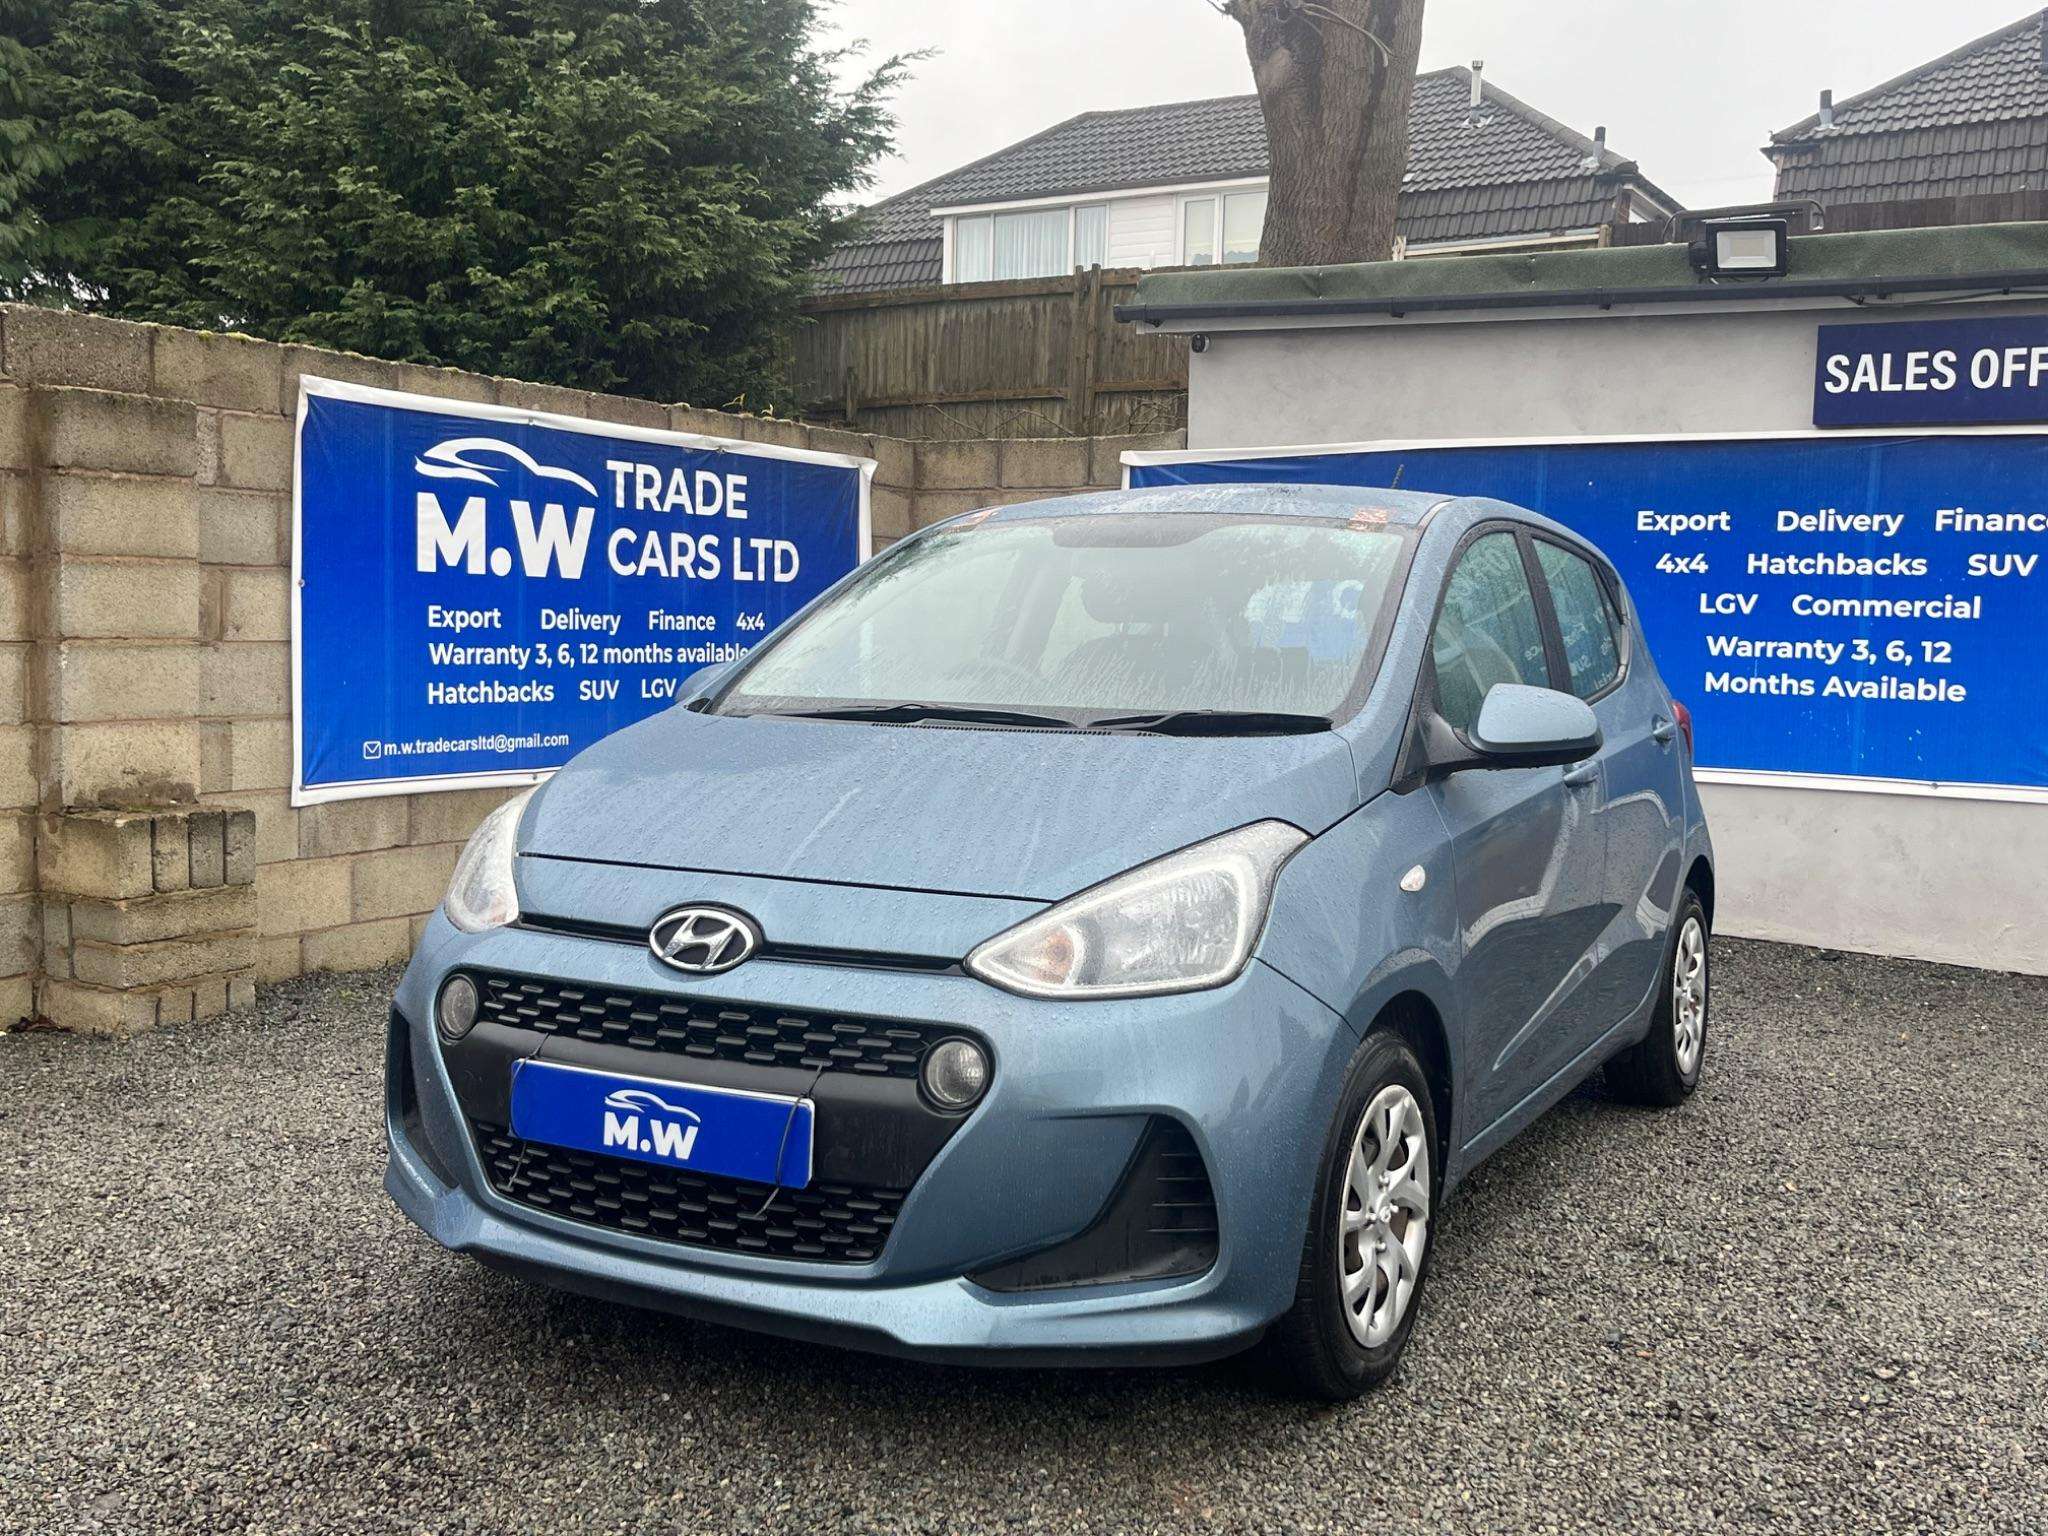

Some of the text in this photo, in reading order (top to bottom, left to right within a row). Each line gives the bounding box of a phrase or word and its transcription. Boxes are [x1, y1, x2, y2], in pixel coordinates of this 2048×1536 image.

[1825, 347, 2048, 393] SALES OFF
[607, 460, 747, 519] TRADE
[416, 492, 596, 580] M.W
[1638, 508, 2048, 536] Export Delivery Financ
[608, 528, 799, 582] CARS LTD
[1656, 553, 2038, 576] 4x4 Hatchbacks SUV
[429, 605, 765, 635] Export Delivery Finance 4x4
[1700, 594, 1980, 618] LGV Commercial
[429, 643, 530, 669] Warranty
[536, 644, 552, 667] 3,
[558, 644, 574, 667] 6,
[580, 644, 598, 663] 12
[604, 644, 672, 663] months
[1707, 636, 1951, 665] Warranty 3, 6, 12
[429, 679, 676, 704] Hatchbacks SUV LGV
[1706, 672, 1966, 702] Months Available
[384, 734, 568, 755] m.w.tradecarsltd@gmail.com
[603, 1111, 699, 1160] M.W
